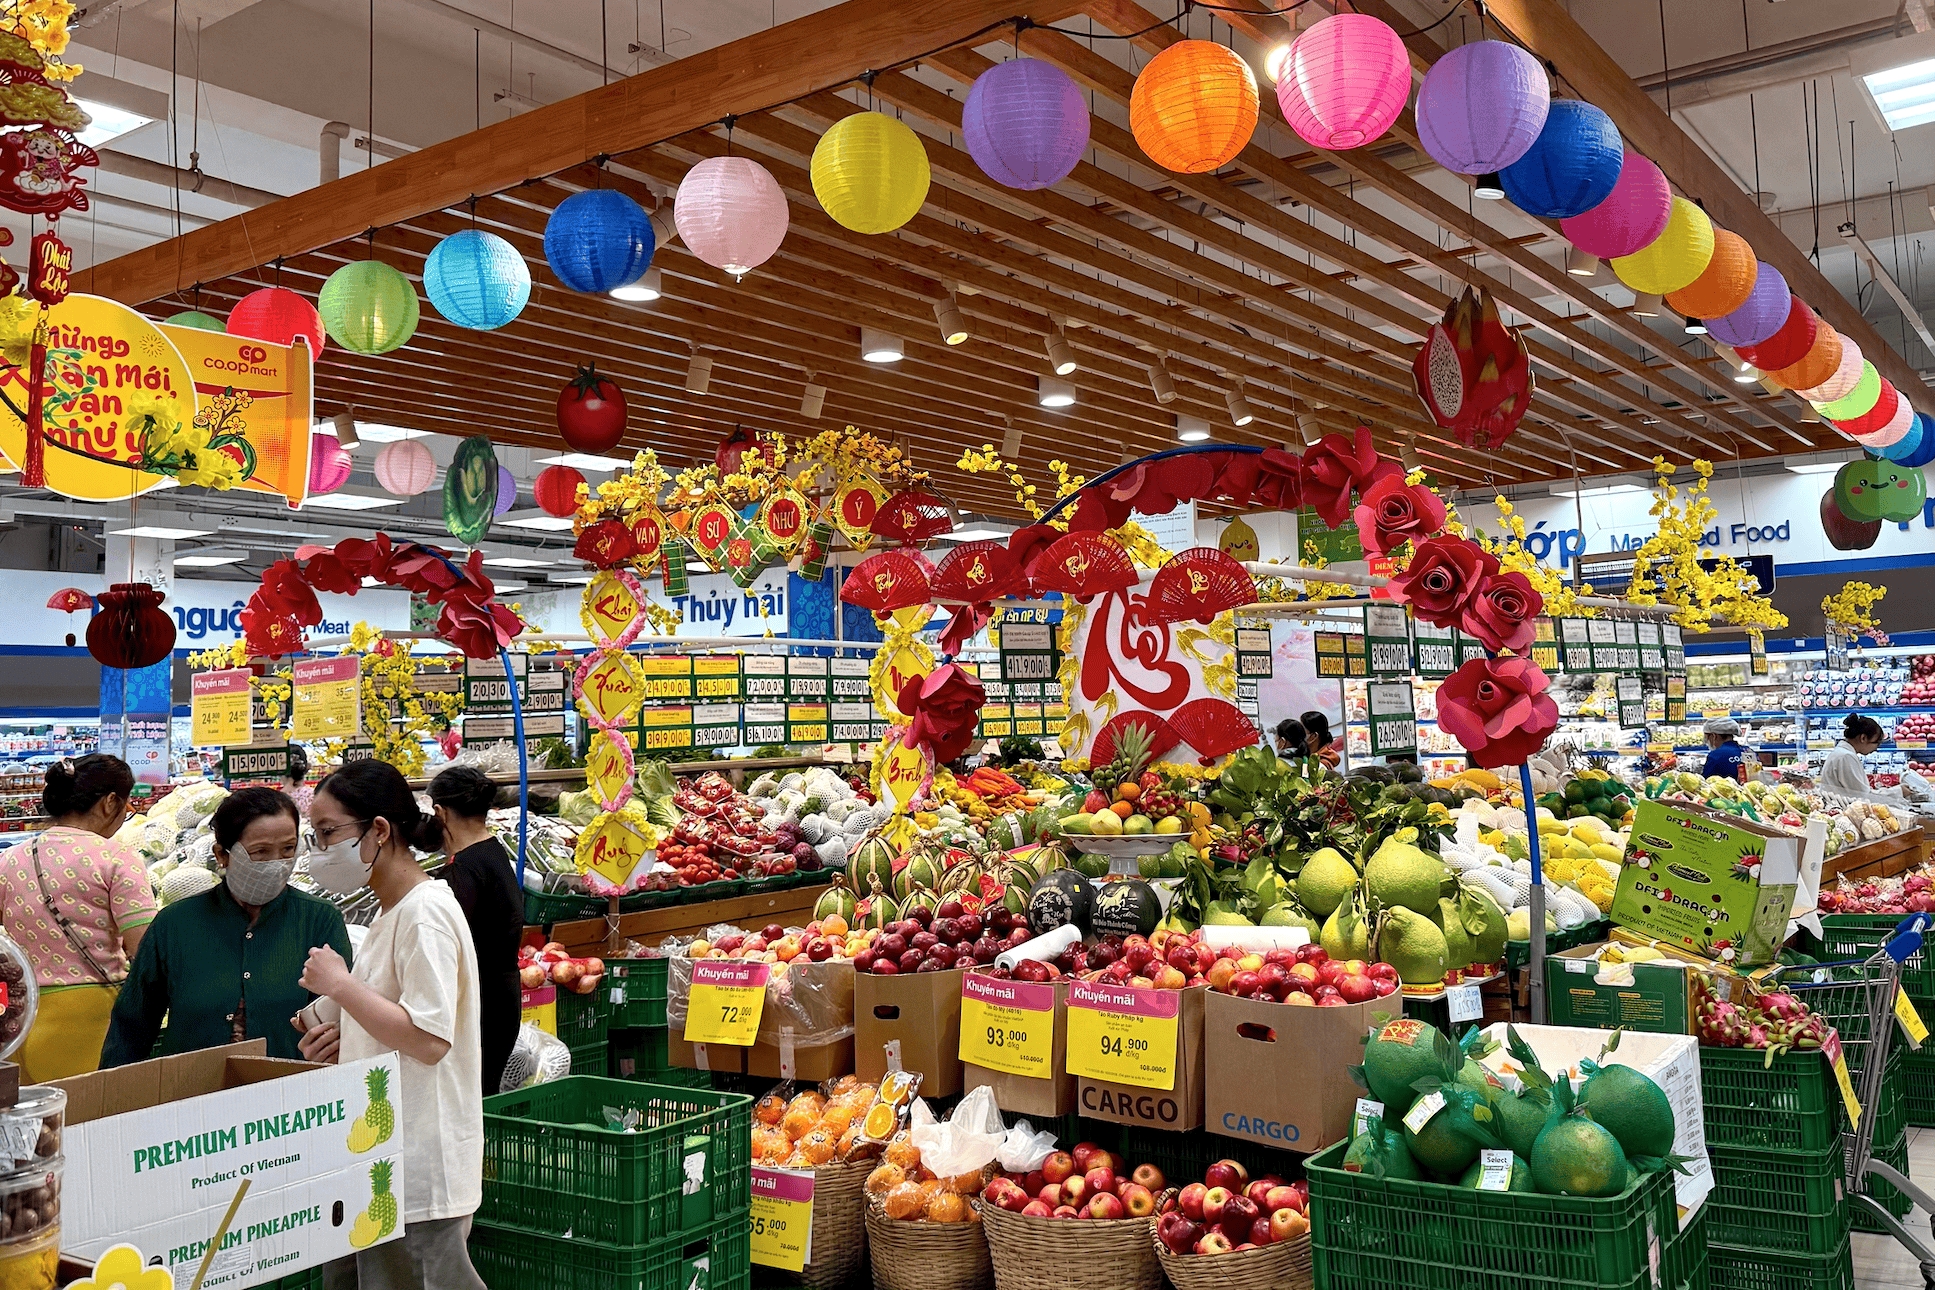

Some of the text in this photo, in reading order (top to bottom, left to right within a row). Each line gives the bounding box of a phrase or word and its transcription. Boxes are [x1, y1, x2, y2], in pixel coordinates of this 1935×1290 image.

[636, 497, 865, 548] VẠN SỰ NHƯ Ý
[1731, 519, 1789, 544] Food
[672, 583, 786, 627] Thủy hải
[313, 621, 350, 635] Meat
[1007, 659, 1044, 674] 41.900
[230, 754, 277, 773] 15.900
[697, 967, 750, 981] Khuyến mãi
[965, 977, 1015, 1000] Khuyến mãi
[1073, 986, 1135, 1006] Khuyến mãi
[721, 1006, 738, 1022] 72
[987, 1026, 1027, 1047] 93 .000
[1101, 1035, 1148, 1057] 94 .900
[1082, 1087, 1178, 1122] CARGO
[133, 1099, 346, 1174] PREMIUM PINEAPPLE
[1223, 1112, 1300, 1142] CARGO
[1486, 1156, 1508, 1164] Select
[192, 1153, 301, 1189] Product Of Vietnam
[757, 1177, 777, 1190] mãi
[169, 1204, 321, 1267] PREMUM PINEAPPLE
[767, 1219, 787, 1231] .000
[257, 1251, 300, 1272] Vietnam
